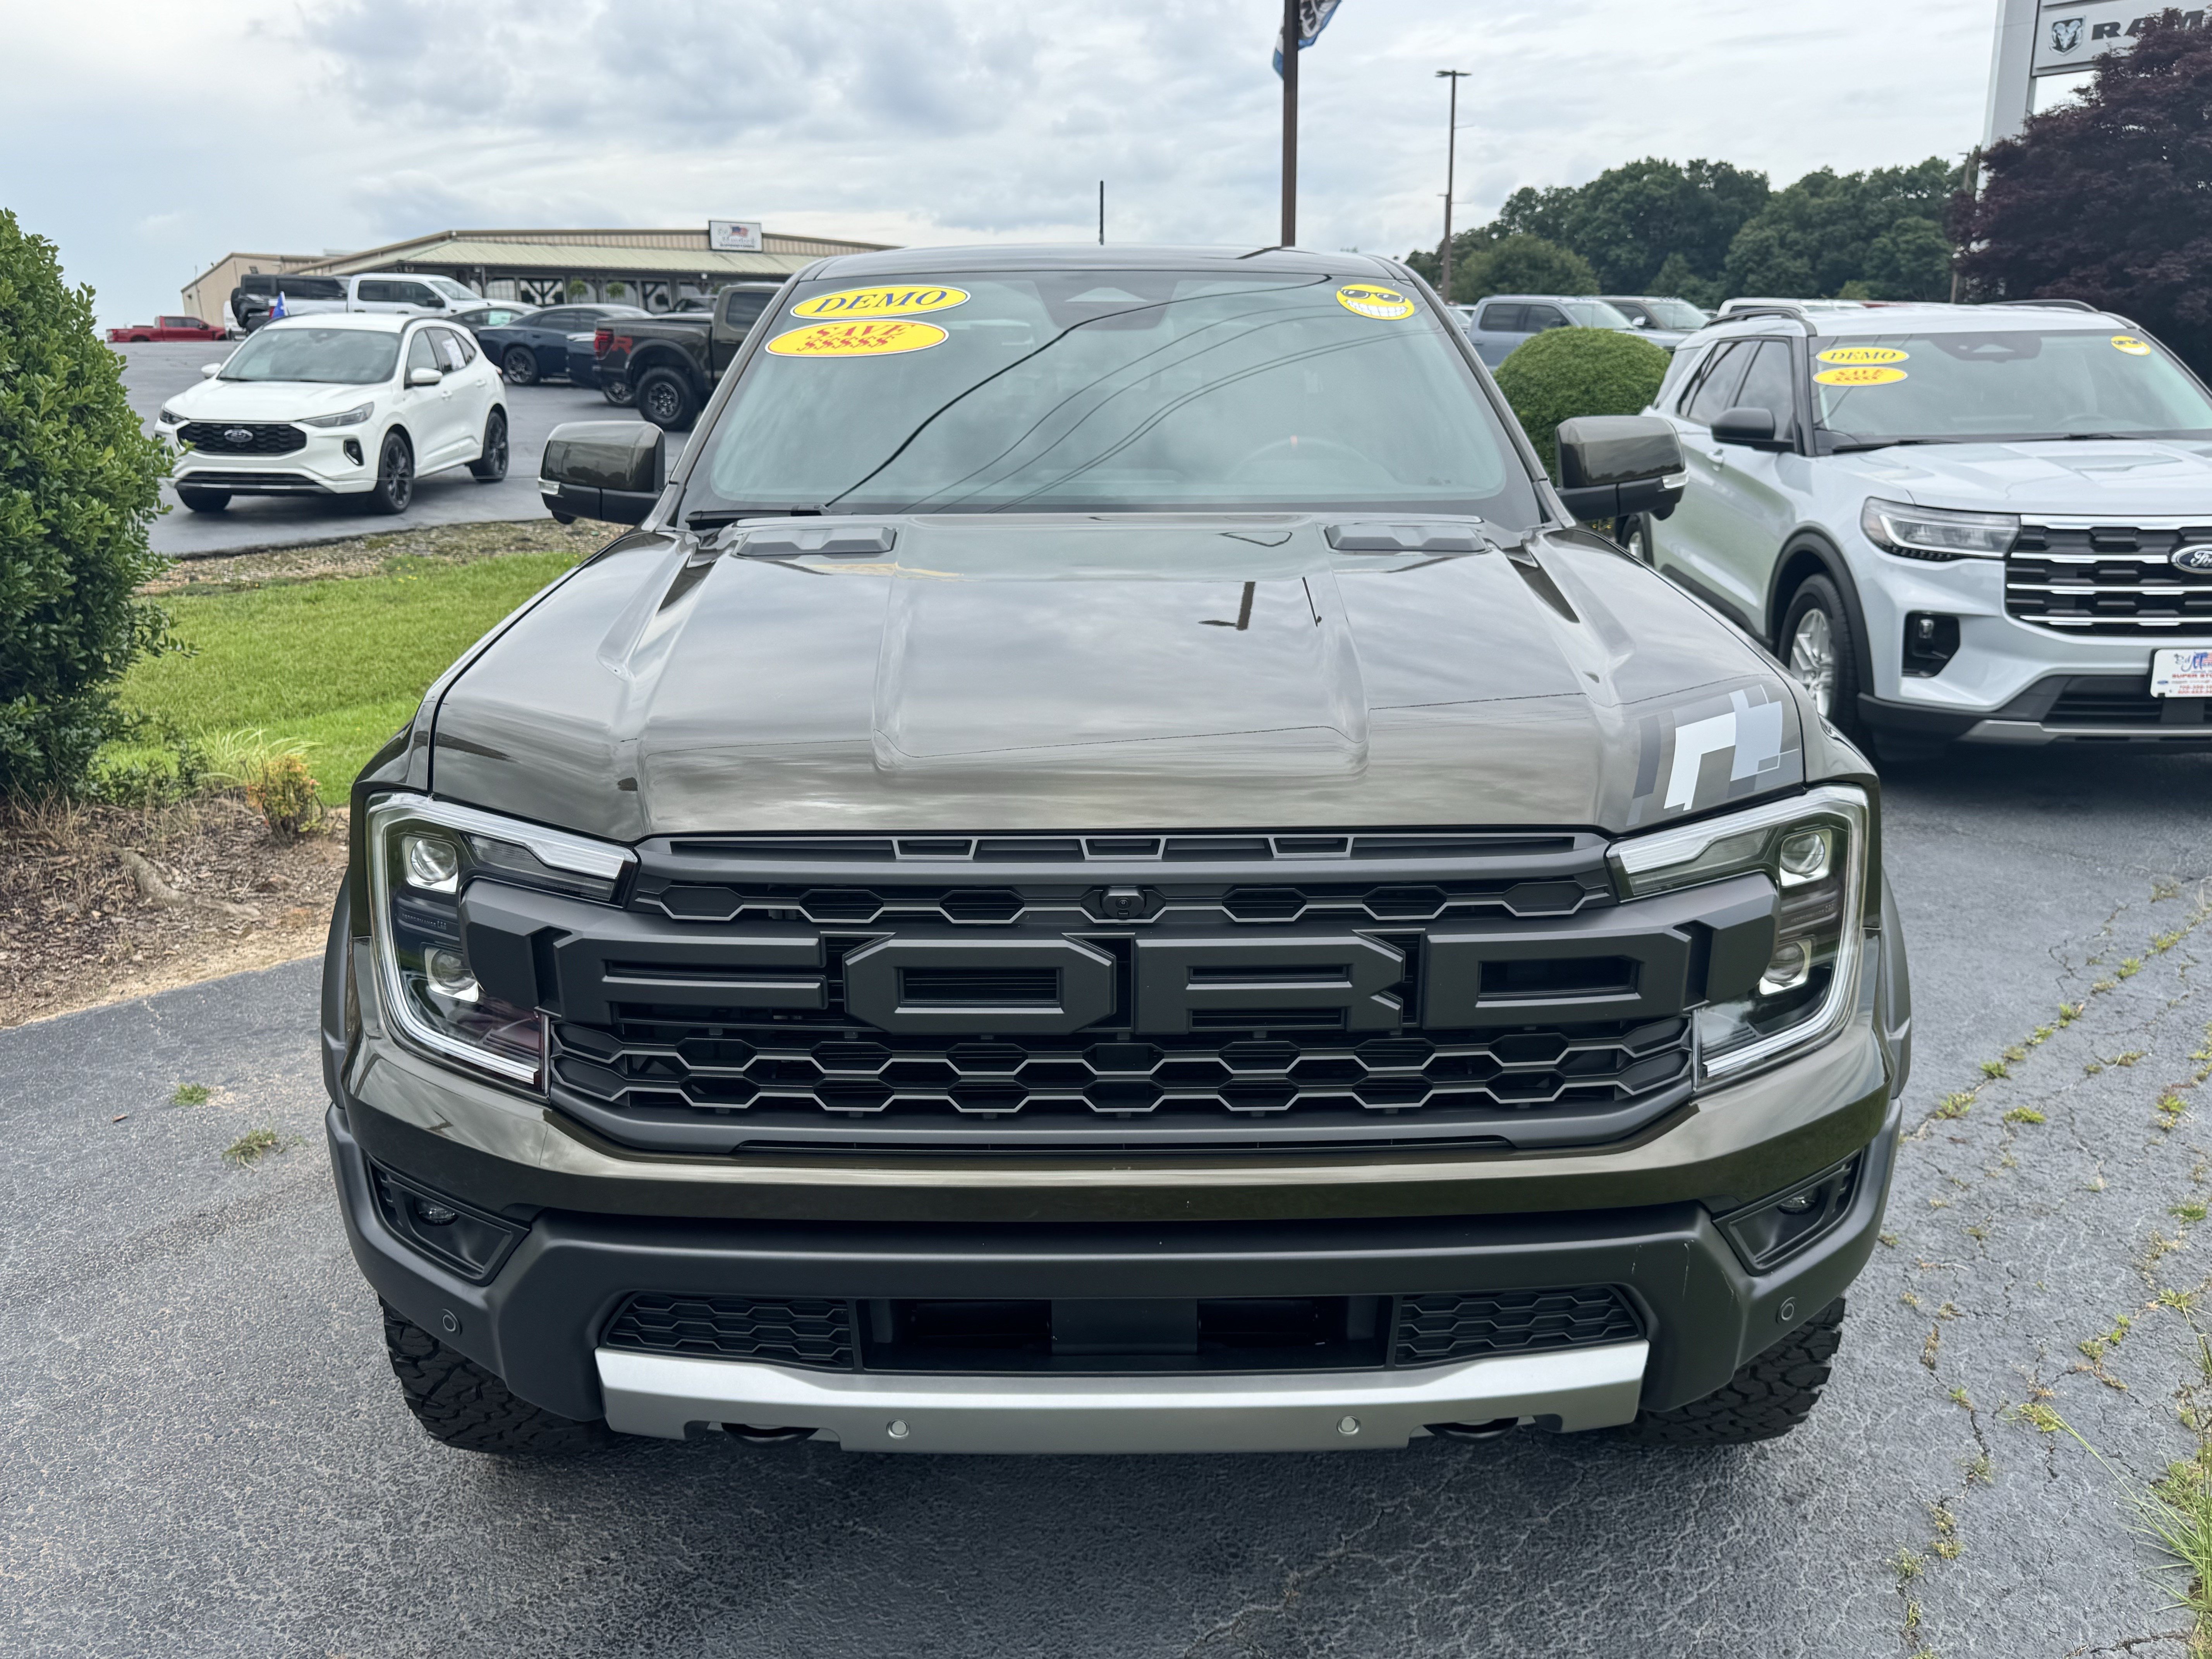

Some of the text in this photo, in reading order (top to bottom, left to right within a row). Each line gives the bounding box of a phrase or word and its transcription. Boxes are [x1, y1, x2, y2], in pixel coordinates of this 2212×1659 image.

[811, 290, 947, 314] DEMO
[806, 324, 917, 340] SAVE
[796, 335, 895, 352] $$$$$
[1830, 351, 1896, 360] DEMO
[554, 925, 1691, 1035] FORD
